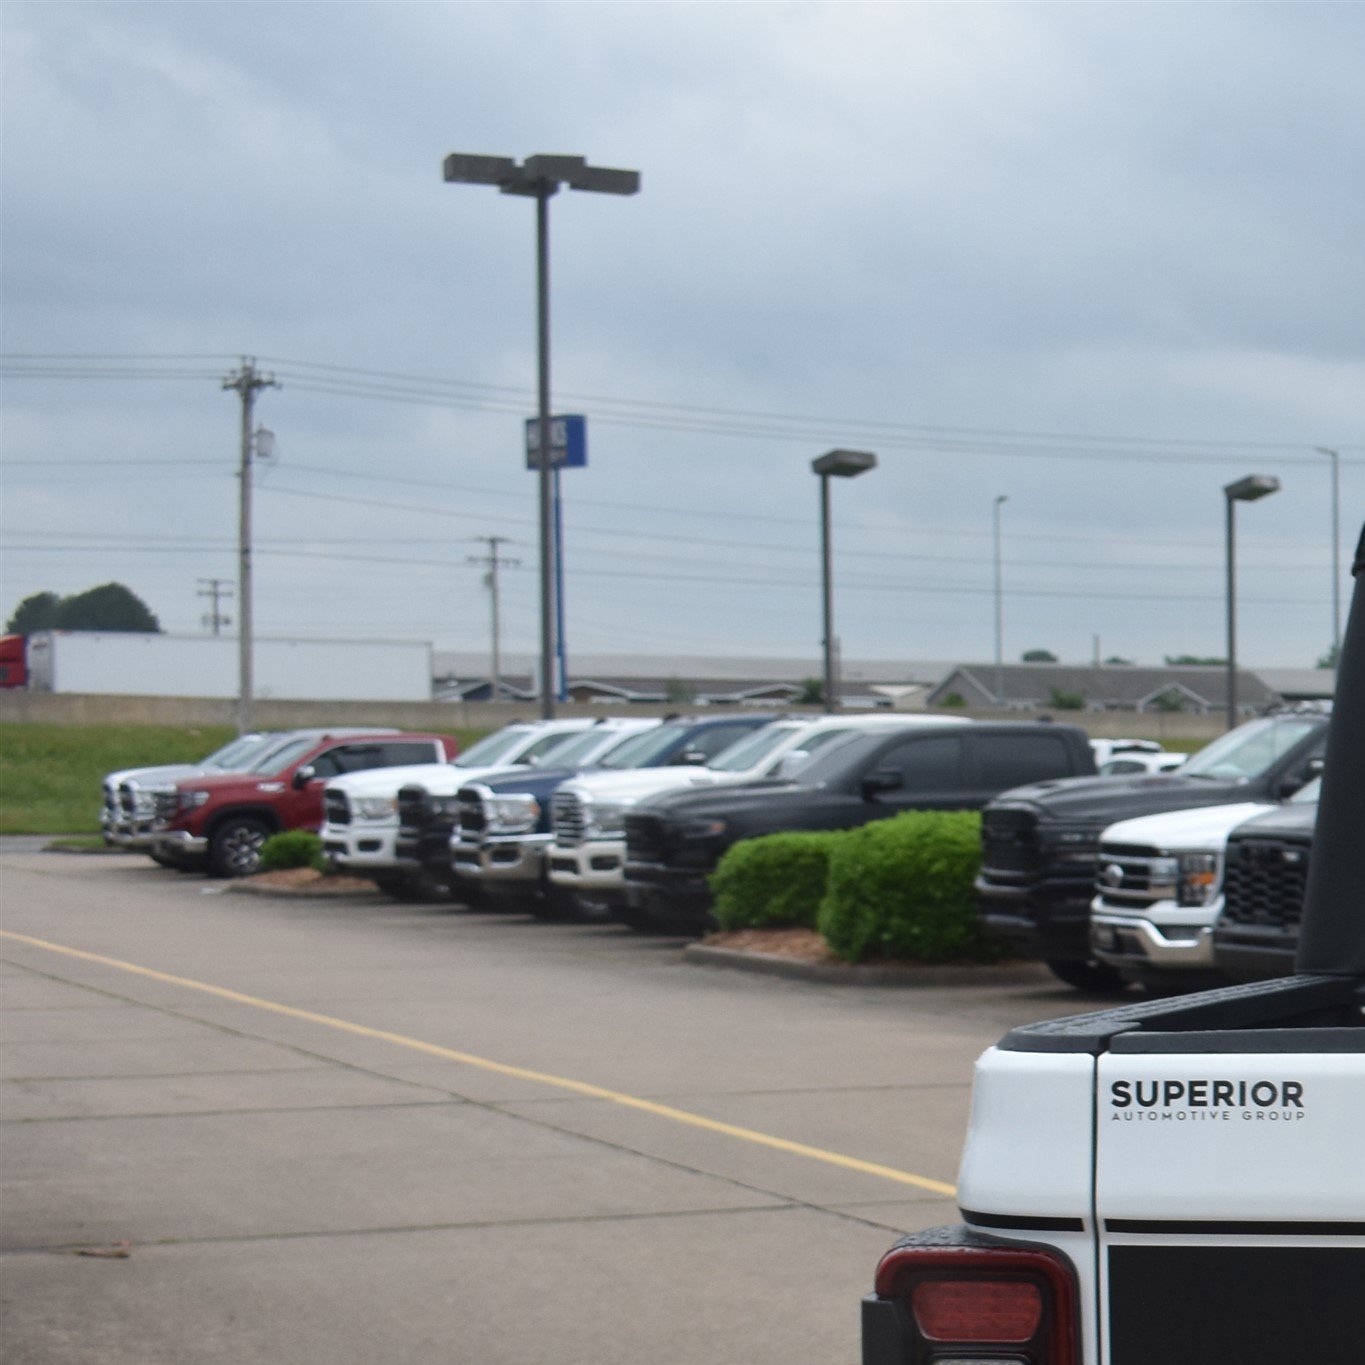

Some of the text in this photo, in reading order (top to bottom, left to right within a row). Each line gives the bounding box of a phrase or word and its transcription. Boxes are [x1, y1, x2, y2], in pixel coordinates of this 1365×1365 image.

[1111, 1080, 1304, 1108] SUPERIOR
[1111, 1110, 1305, 1122] AUTOMOTIVE GROUP
